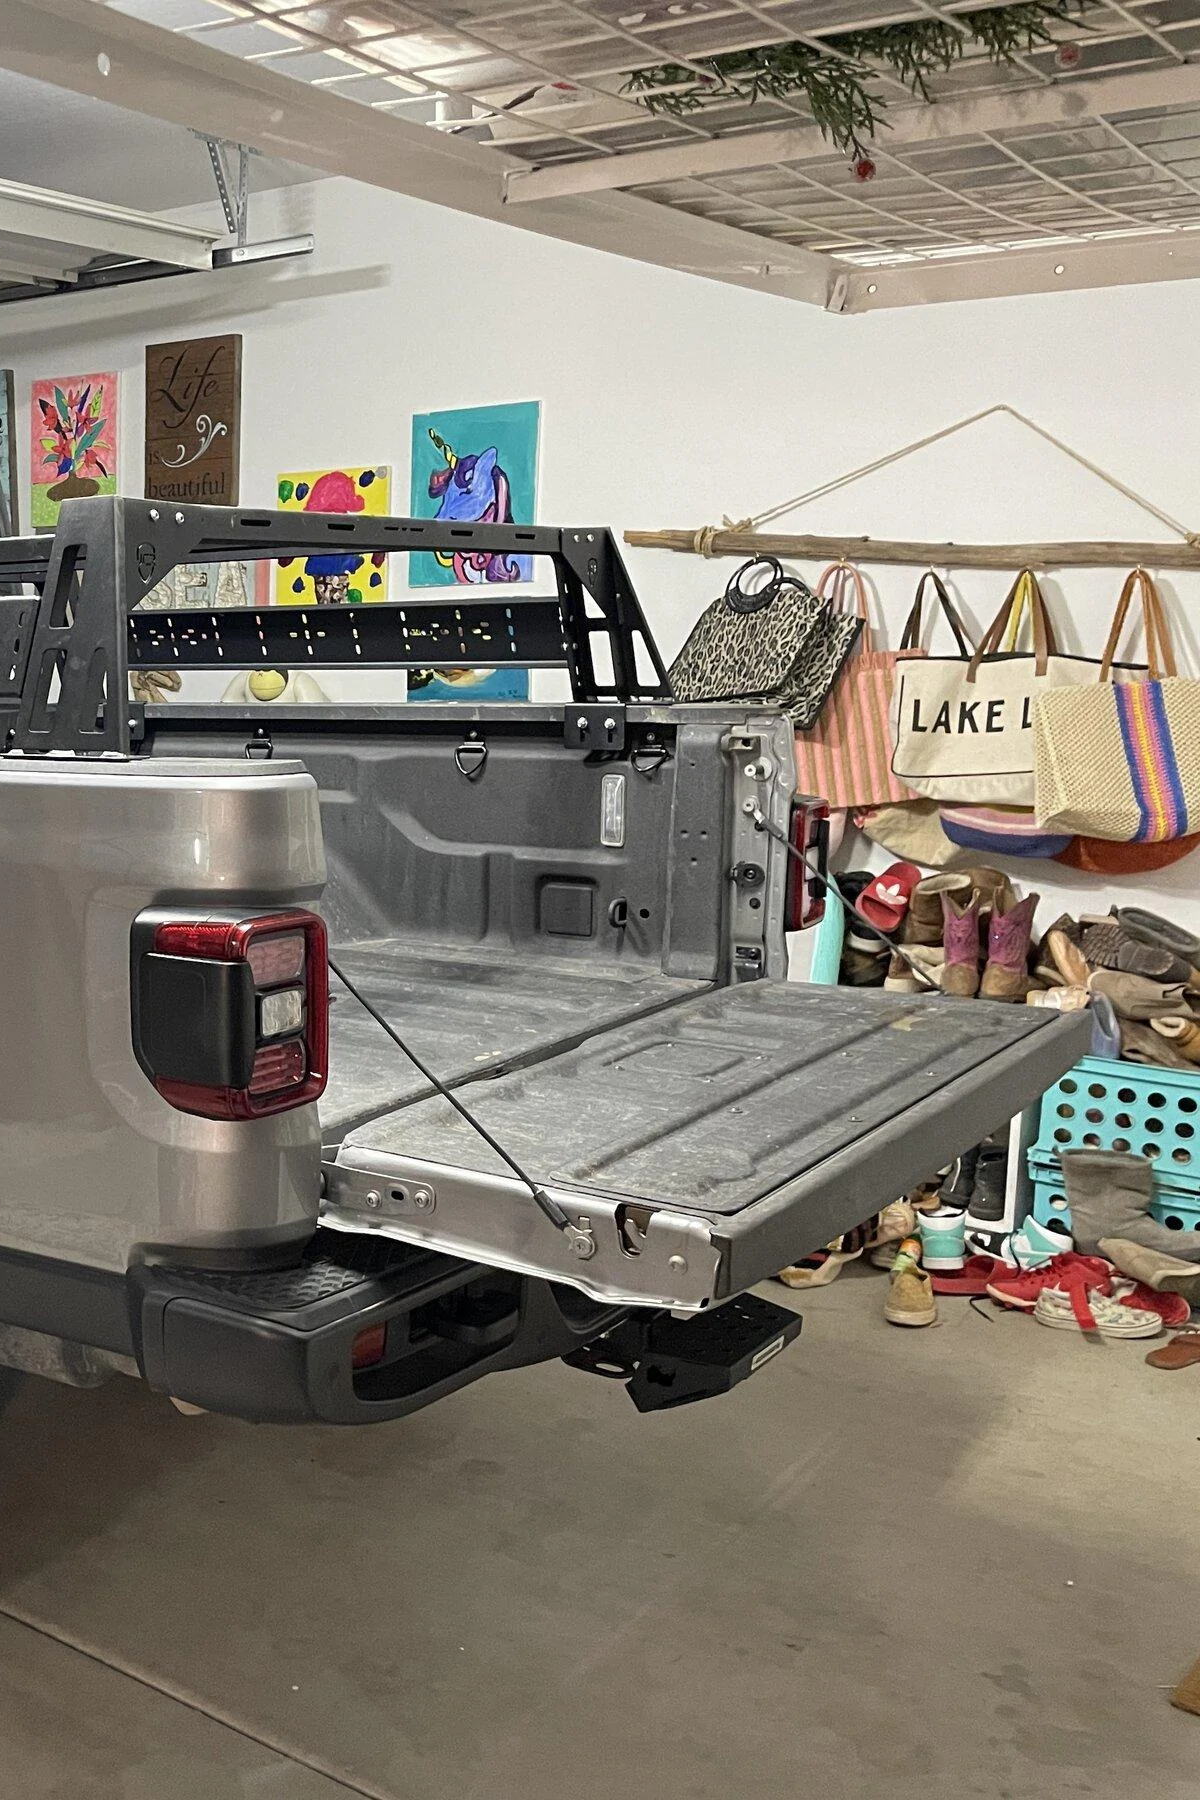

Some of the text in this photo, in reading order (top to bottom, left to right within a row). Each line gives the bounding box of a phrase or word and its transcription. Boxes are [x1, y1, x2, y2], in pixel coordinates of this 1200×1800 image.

[151, 345, 226, 428] Life
[149, 450, 160, 466] is
[149, 472, 226, 498] beautiful
[911, 698, 1006, 734] LAKE
